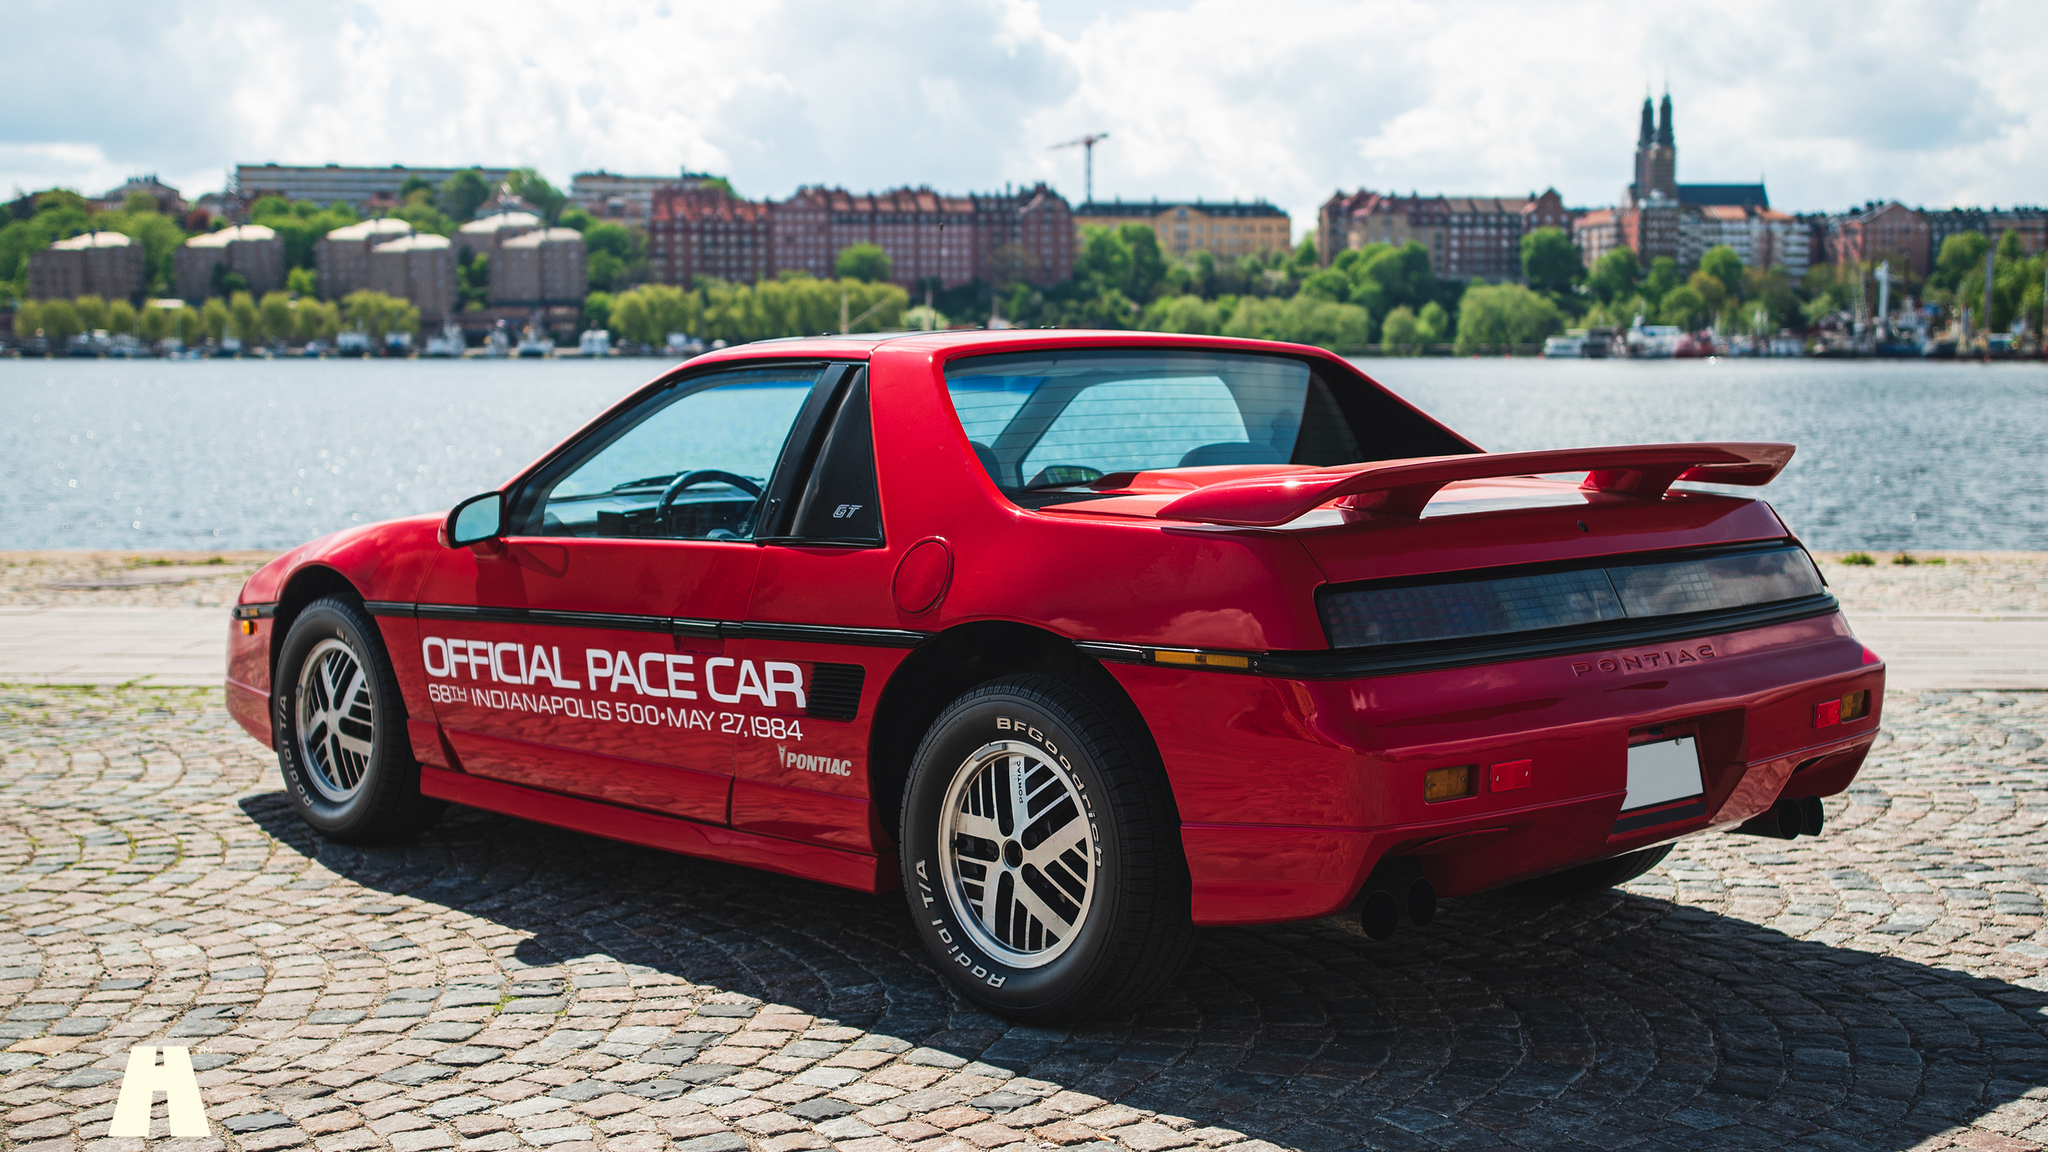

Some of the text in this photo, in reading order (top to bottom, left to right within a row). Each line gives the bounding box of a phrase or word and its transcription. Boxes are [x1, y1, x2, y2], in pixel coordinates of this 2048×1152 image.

[833, 504, 863, 519] GT
[422, 636, 580, 690] OFFICIAL
[586, 648, 698, 700] PACE
[705, 656, 807, 708] CAR
[1571, 644, 1716, 677] PONTIAC
[471, 687, 612, 721] INDIANAPOLIS
[786, 752, 852, 777] PONTIAC
[996, 716, 1103, 868] BFGoodrich
[915, 859, 1007, 989] Radial T/A
